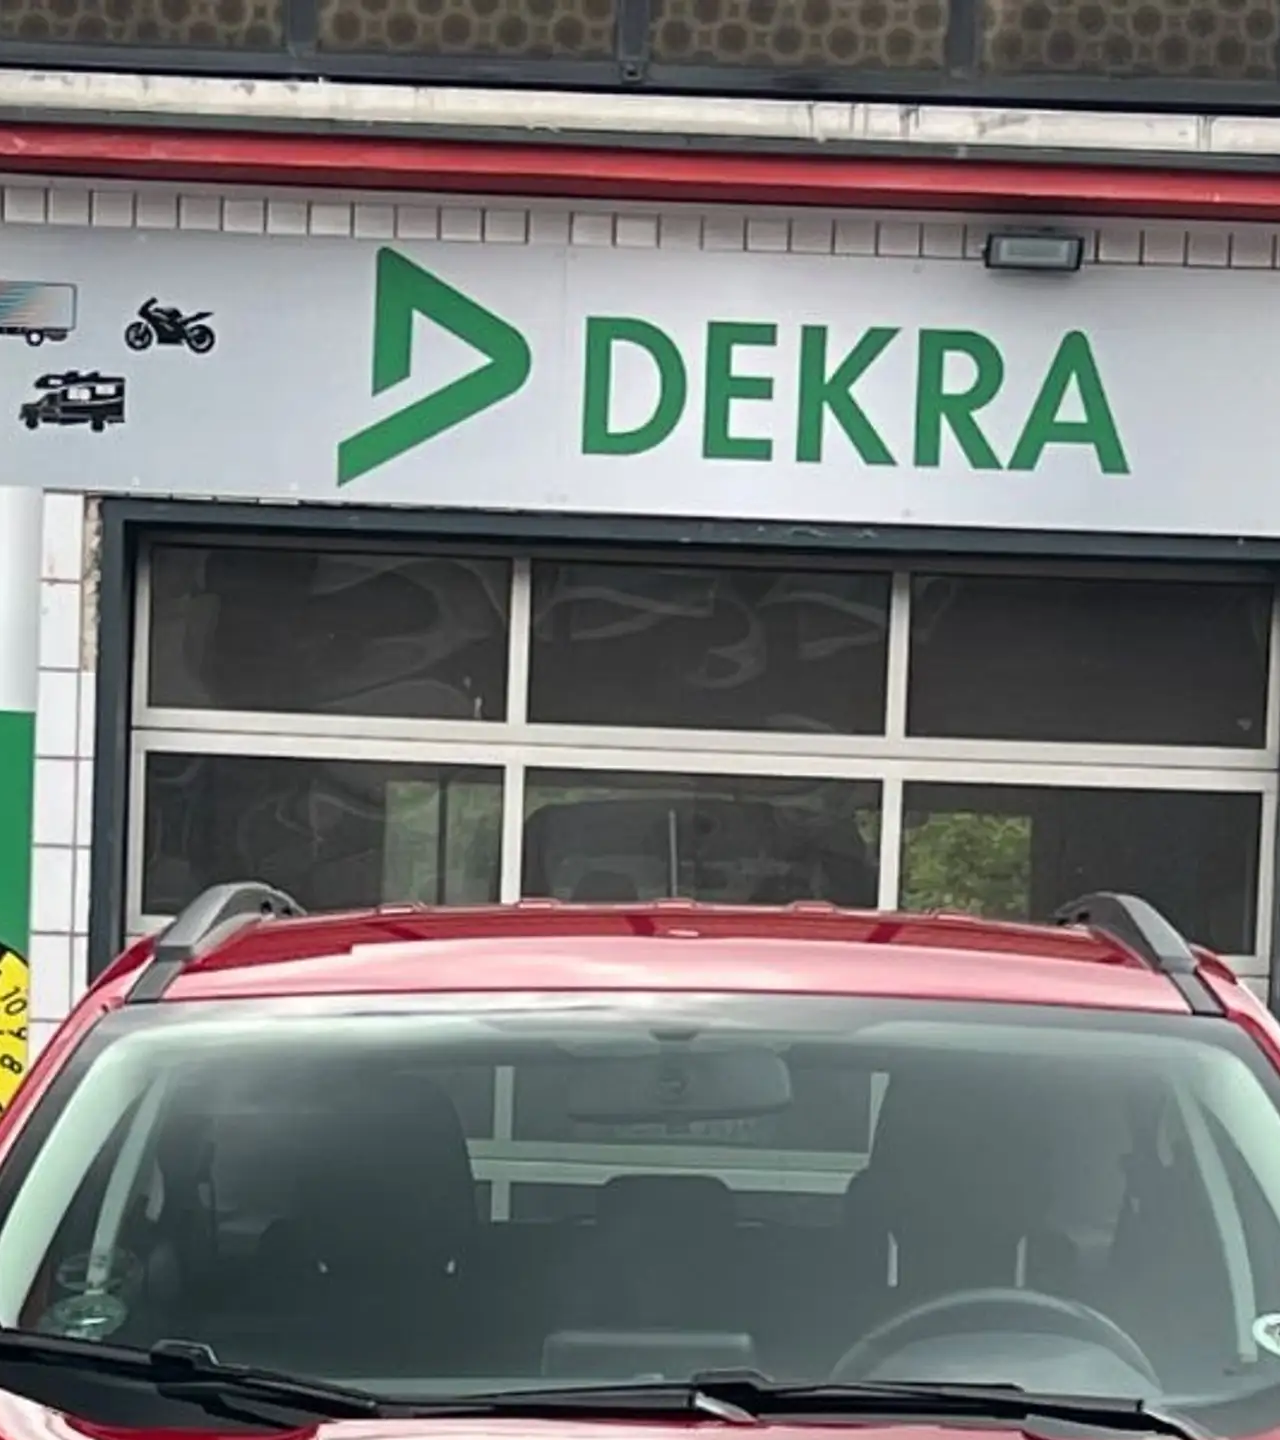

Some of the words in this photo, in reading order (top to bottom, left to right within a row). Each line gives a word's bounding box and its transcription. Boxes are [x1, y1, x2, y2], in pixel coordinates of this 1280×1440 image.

[581, 316, 1131, 474] DEKRA
[0, 987, 27, 1016] 10
[0, 1054, 24, 1074] 8
